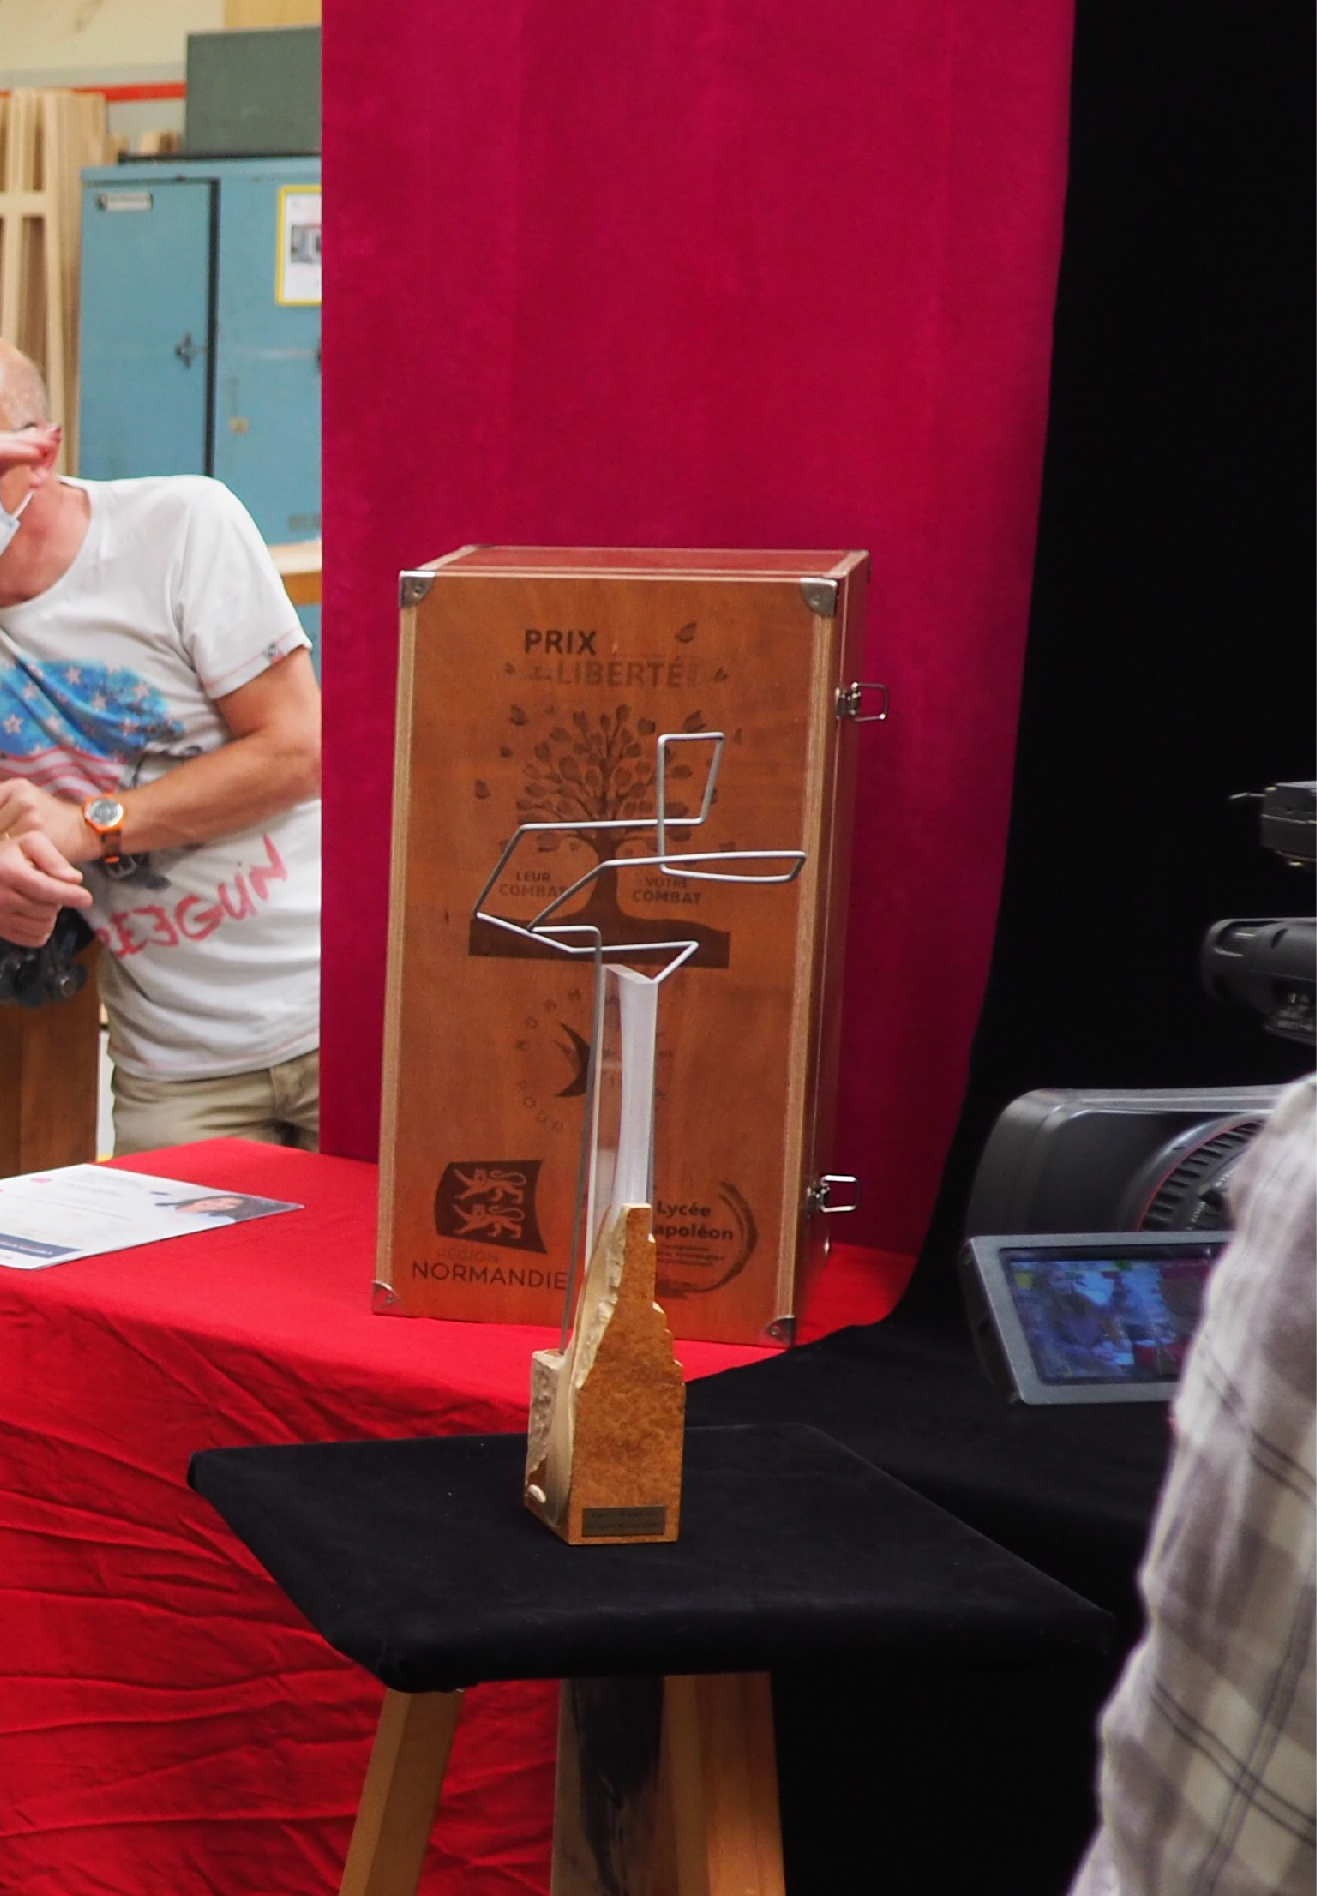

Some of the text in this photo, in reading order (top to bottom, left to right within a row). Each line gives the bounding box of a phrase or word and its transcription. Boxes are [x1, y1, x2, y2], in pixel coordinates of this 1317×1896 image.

[524, 629, 598, 656] PRIX
[556, 657, 685, 688] LIBERTÉ
[632, 890, 702, 904] COMBAT
[657, 1201, 711, 1218] Lycée
[653, 1225, 733, 1239] apoléon
[411, 1261, 568, 1290] NORMANDIE
